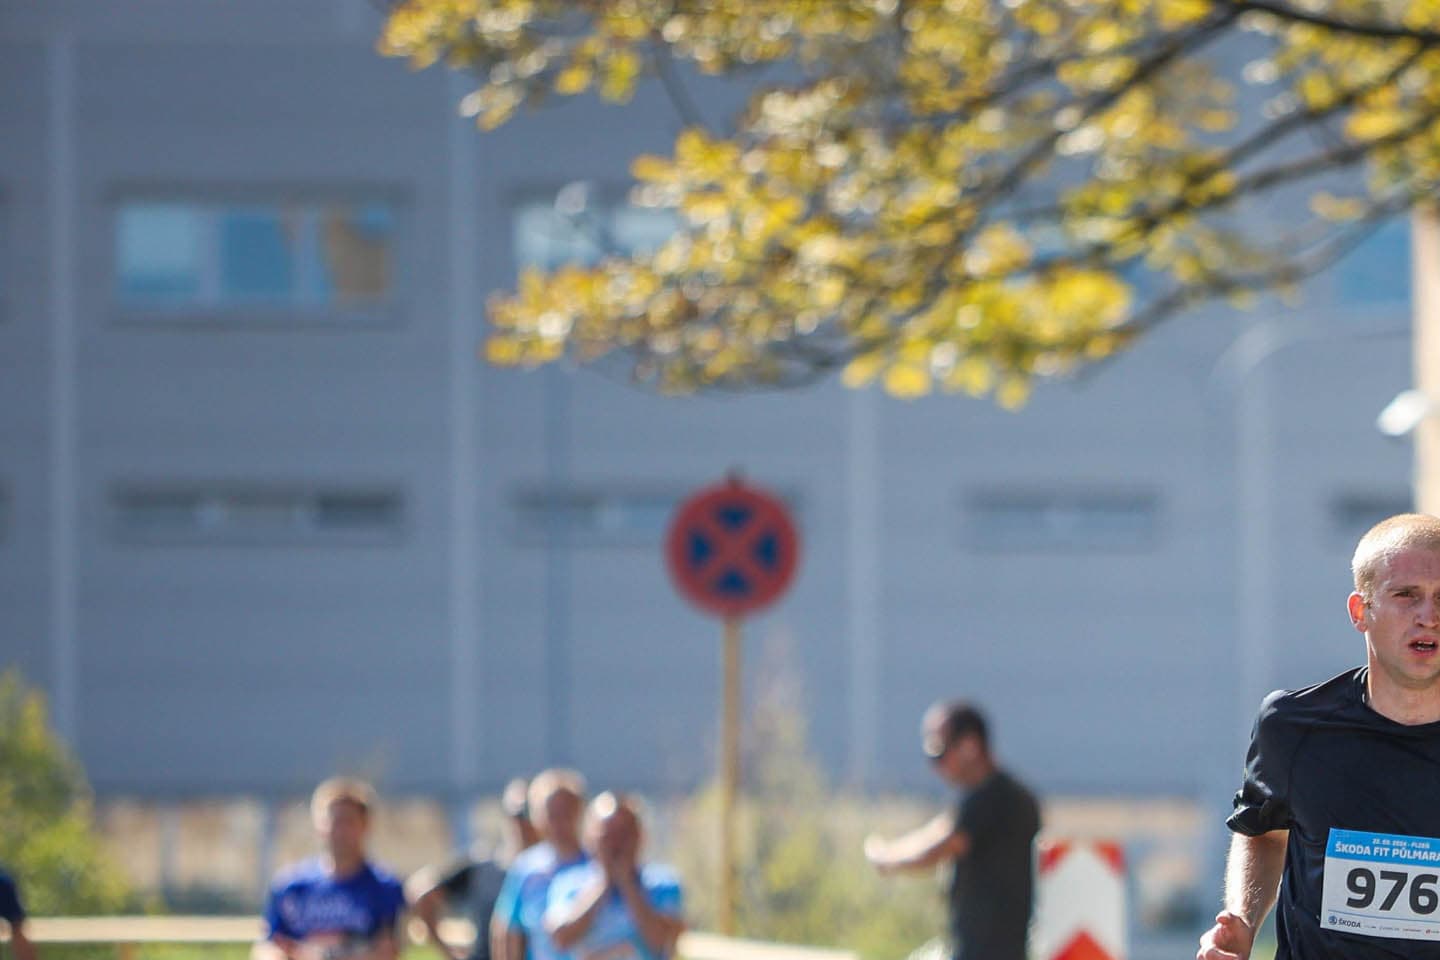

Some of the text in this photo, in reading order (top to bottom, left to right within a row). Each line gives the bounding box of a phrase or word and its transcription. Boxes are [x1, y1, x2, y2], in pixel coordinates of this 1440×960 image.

[1335, 841, 1371, 855] ŠKODA
[1373, 847, 1390, 857] FIT
[1346, 867, 1439, 915] 976
[1338, 917, 1361, 928] ŠKODA
